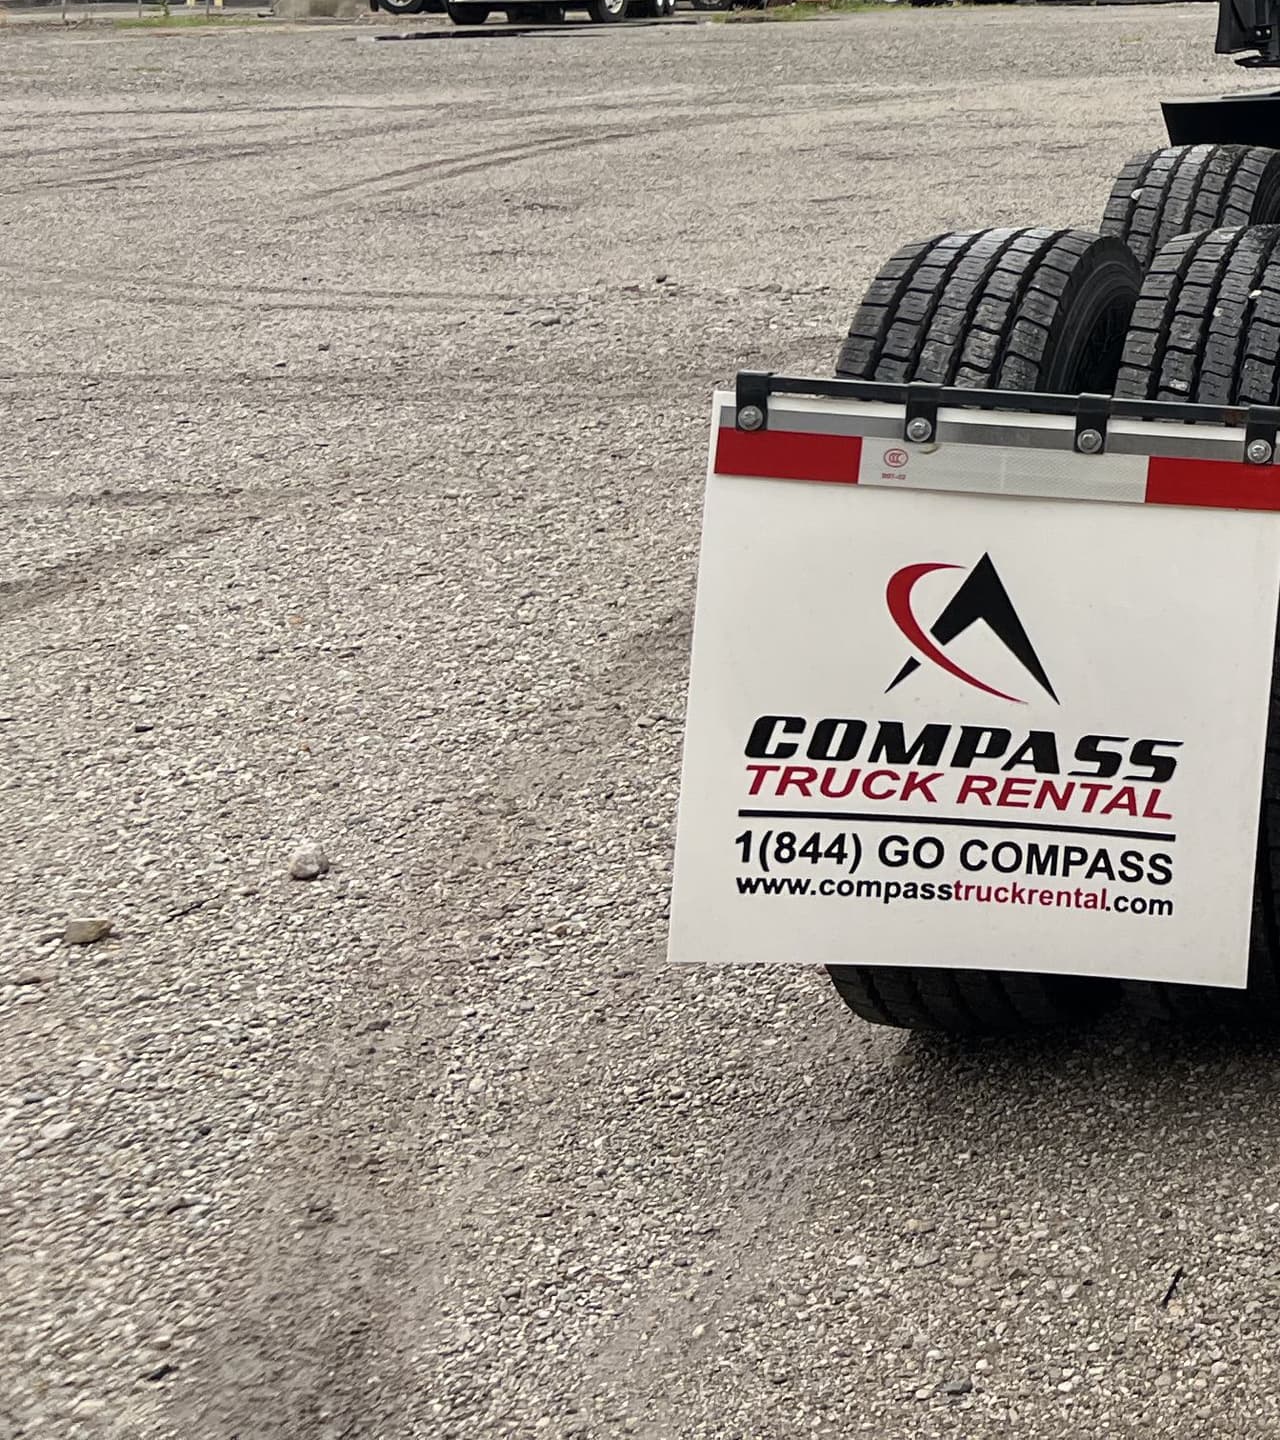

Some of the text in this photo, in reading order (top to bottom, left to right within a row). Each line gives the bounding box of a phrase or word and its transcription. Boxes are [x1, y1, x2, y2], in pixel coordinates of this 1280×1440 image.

[743, 715, 1185, 783] COMPASS
[745, 764, 1173, 820] TRUCK RENTAL
[735, 829, 1174, 885] 1(844) GO COMPASS
[735, 877, 1174, 917] www.compasstruckrental.com
